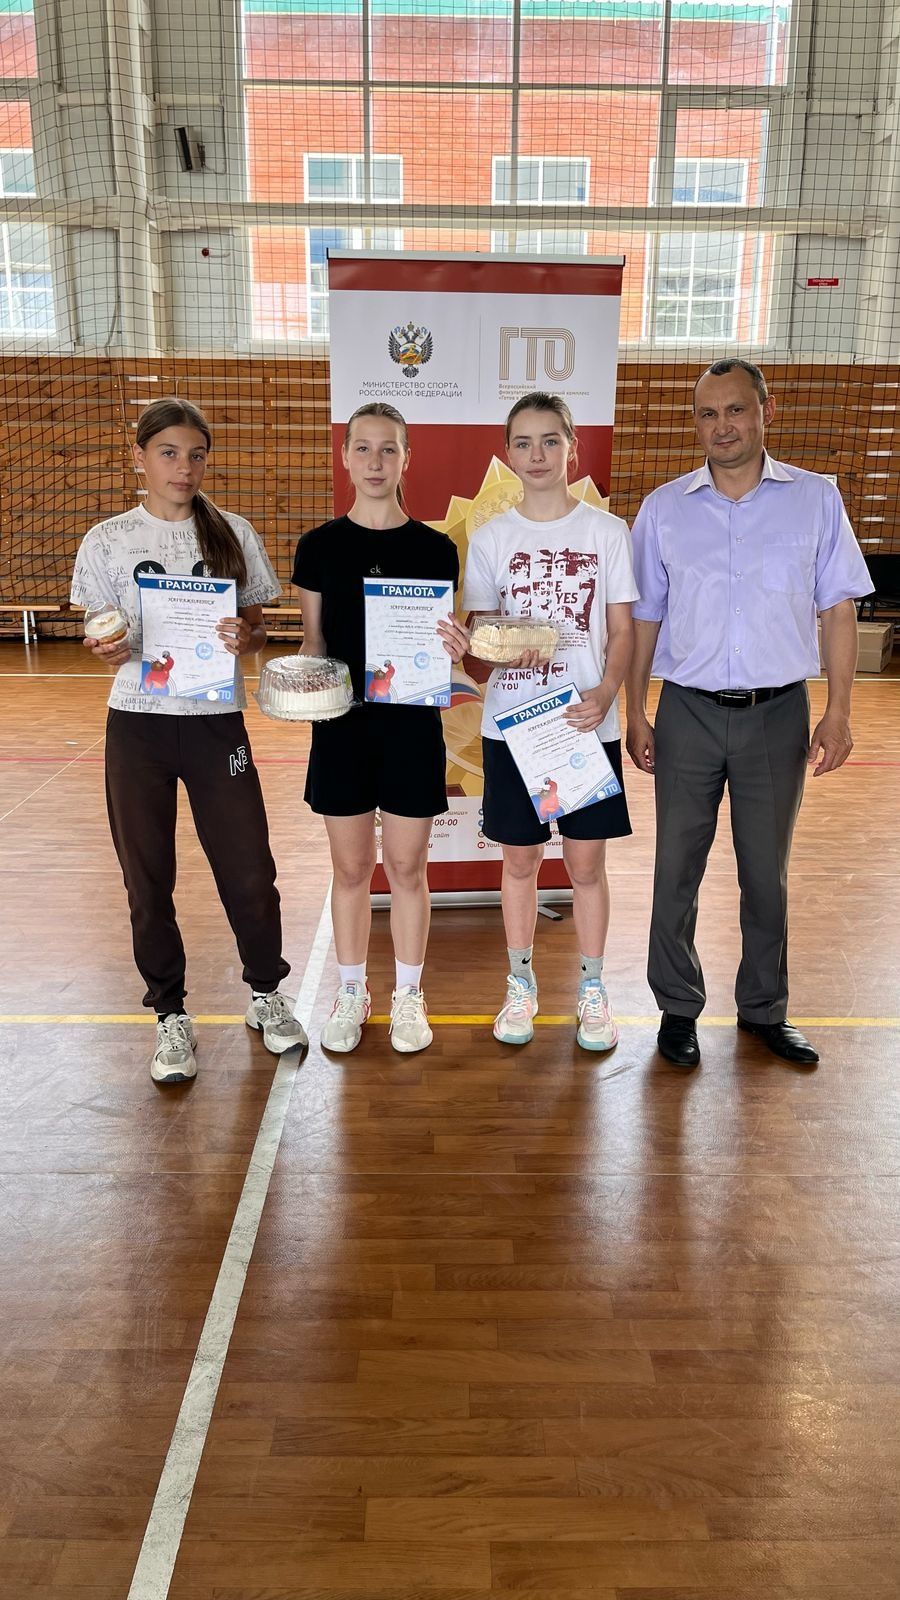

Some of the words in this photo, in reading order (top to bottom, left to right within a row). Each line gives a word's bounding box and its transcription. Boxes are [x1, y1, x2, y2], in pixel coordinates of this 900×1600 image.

[499, 326, 576, 382] ГТО
[362, 381, 426, 389] МИНИСТЕРСТВО
[427, 381, 459, 389] СПОРТА
[359, 388, 413, 397] РОССИЙСКОЙ
[414, 389, 463, 398] ФЕДЕРАЦИИ
[370, 564, 382, 574] ck
[158, 580, 217, 592] ГРАМОТА
[382, 585, 436, 597] ГРАМОТА
[556, 592, 578, 605] YES
[434, 694, 449, 704] ГТО
[512, 697, 563, 724] ГРАМОТА
[603, 783, 618, 796] ГТО
